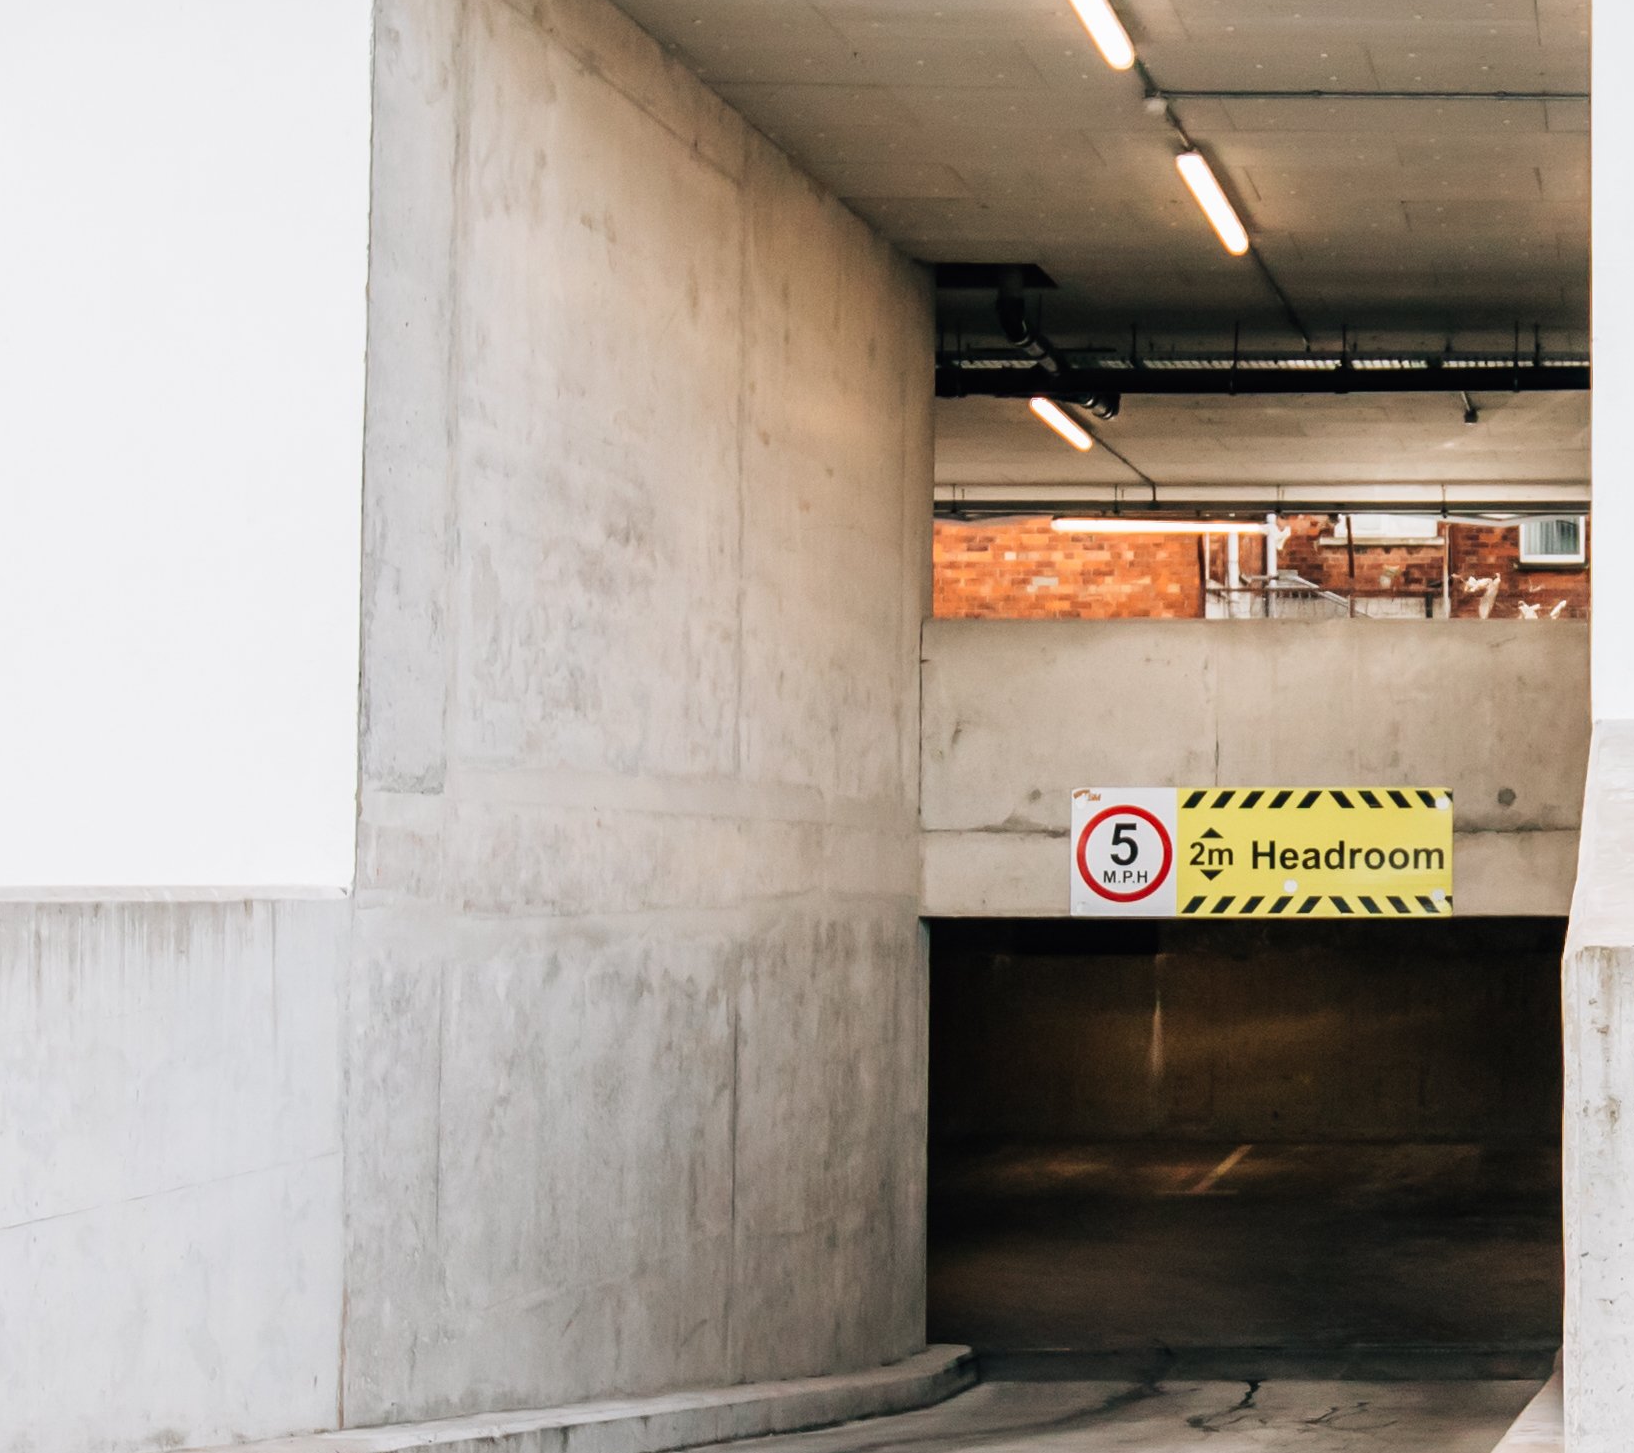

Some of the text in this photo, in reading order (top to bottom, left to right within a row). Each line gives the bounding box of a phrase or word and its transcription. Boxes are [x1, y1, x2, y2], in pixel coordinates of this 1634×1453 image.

[1110, 822, 1139, 866] 5
[1189, 840, 1445, 870] 2m Headroom
[1103, 870, 1148, 884] M.P.H
